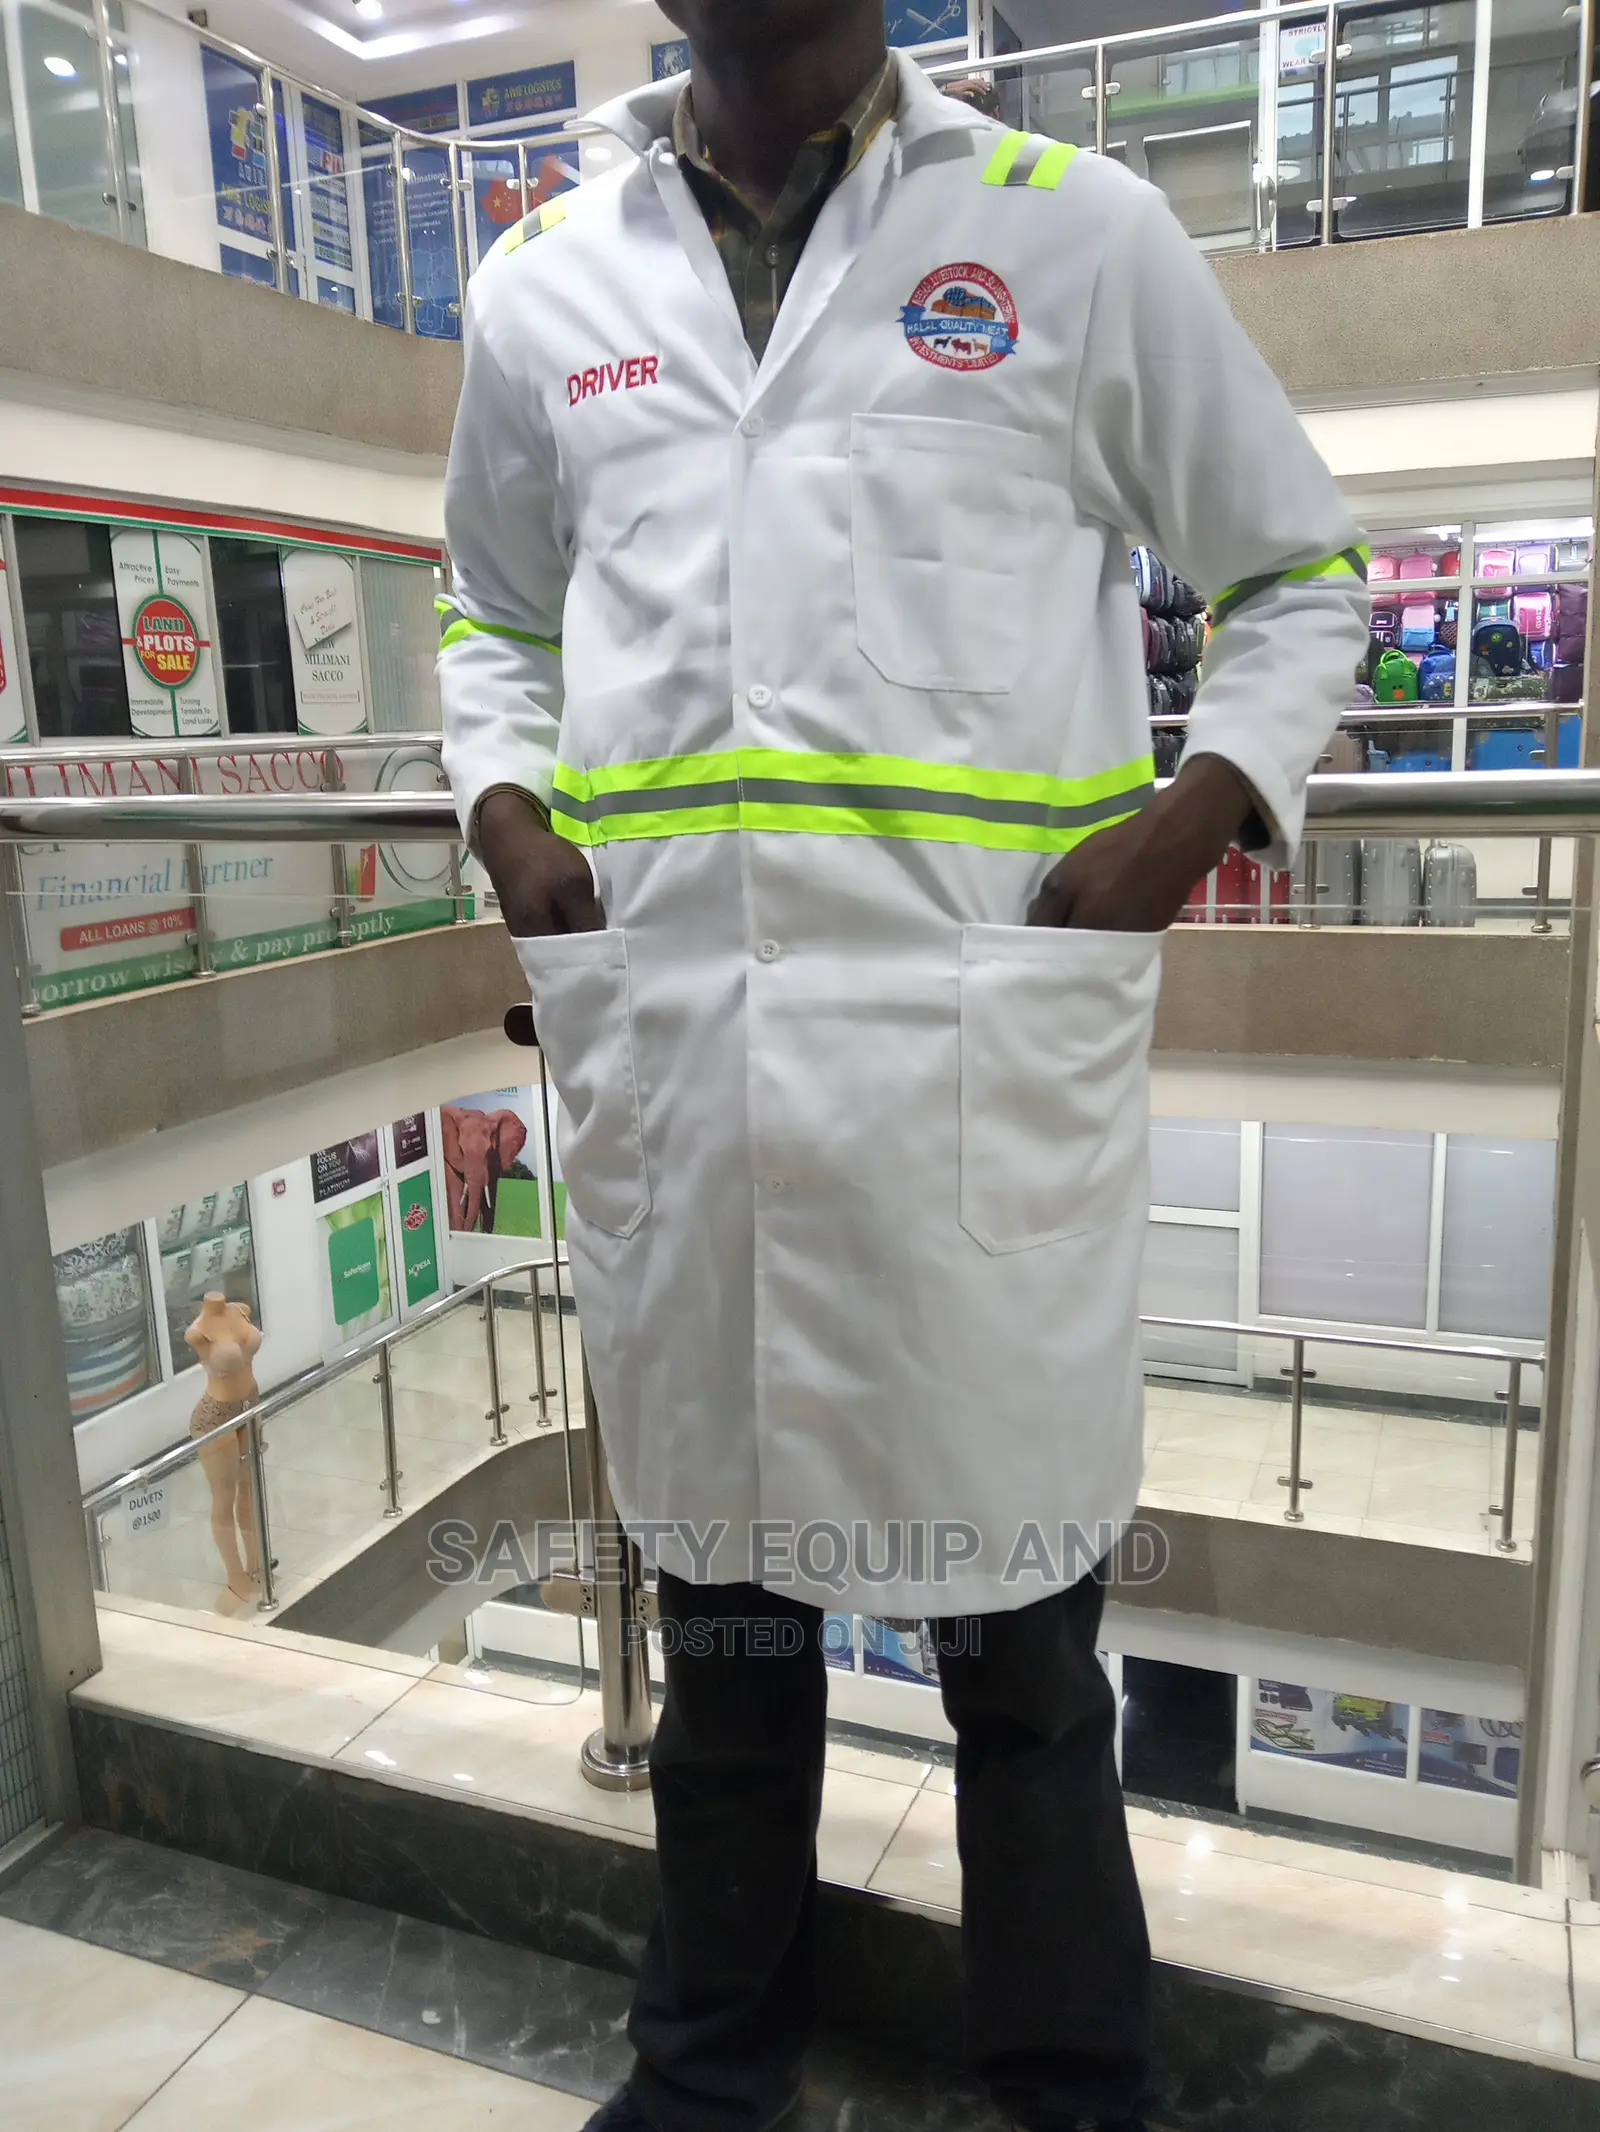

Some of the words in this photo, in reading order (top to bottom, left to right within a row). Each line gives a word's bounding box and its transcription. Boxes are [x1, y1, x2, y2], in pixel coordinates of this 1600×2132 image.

[1288, 24, 1326, 37] STRICTLY
[524, 79, 562, 96] LOGISTICS
[929, 265, 969, 290] LIVESTOCK
[970, 266, 987, 281] AND
[907, 322, 937, 334] HALAL
[940, 319, 978, 332] QUALITY
[908, 337, 963, 368] INVESTMENTS
[566, 355, 659, 408] DRIVER
[118, 561, 153, 573] Attractive
[164, 565, 180, 576] Easy
[134, 574, 155, 585] Prices
[167, 577, 200, 588] Payments
[143, 616, 185, 633] LAND
[143, 634, 195, 652] PLOTS
[140, 650, 156, 660] FOR
[156, 653, 192, 671] SALE
[304, 653, 351, 666] MILIMANI
[311, 669, 344, 682] SACCO
[130, 697, 164, 706] Immediate
[179, 697, 201, 706] Turning
[131, 708, 172, 716] Development
[182, 717, 197, 725] Land
[36, 857, 172, 912] Financial
[79, 929, 103, 944] ALL
[105, 921, 145, 939] LOANS
[148, 919, 159, 934] @
[162, 915, 183, 930] 10%
[229, 938, 249, 963] &
[256, 934, 296, 962] pay
[316, 1151, 338, 1166] FOCUS
[129, 1489, 163, 1511] DUVETS
